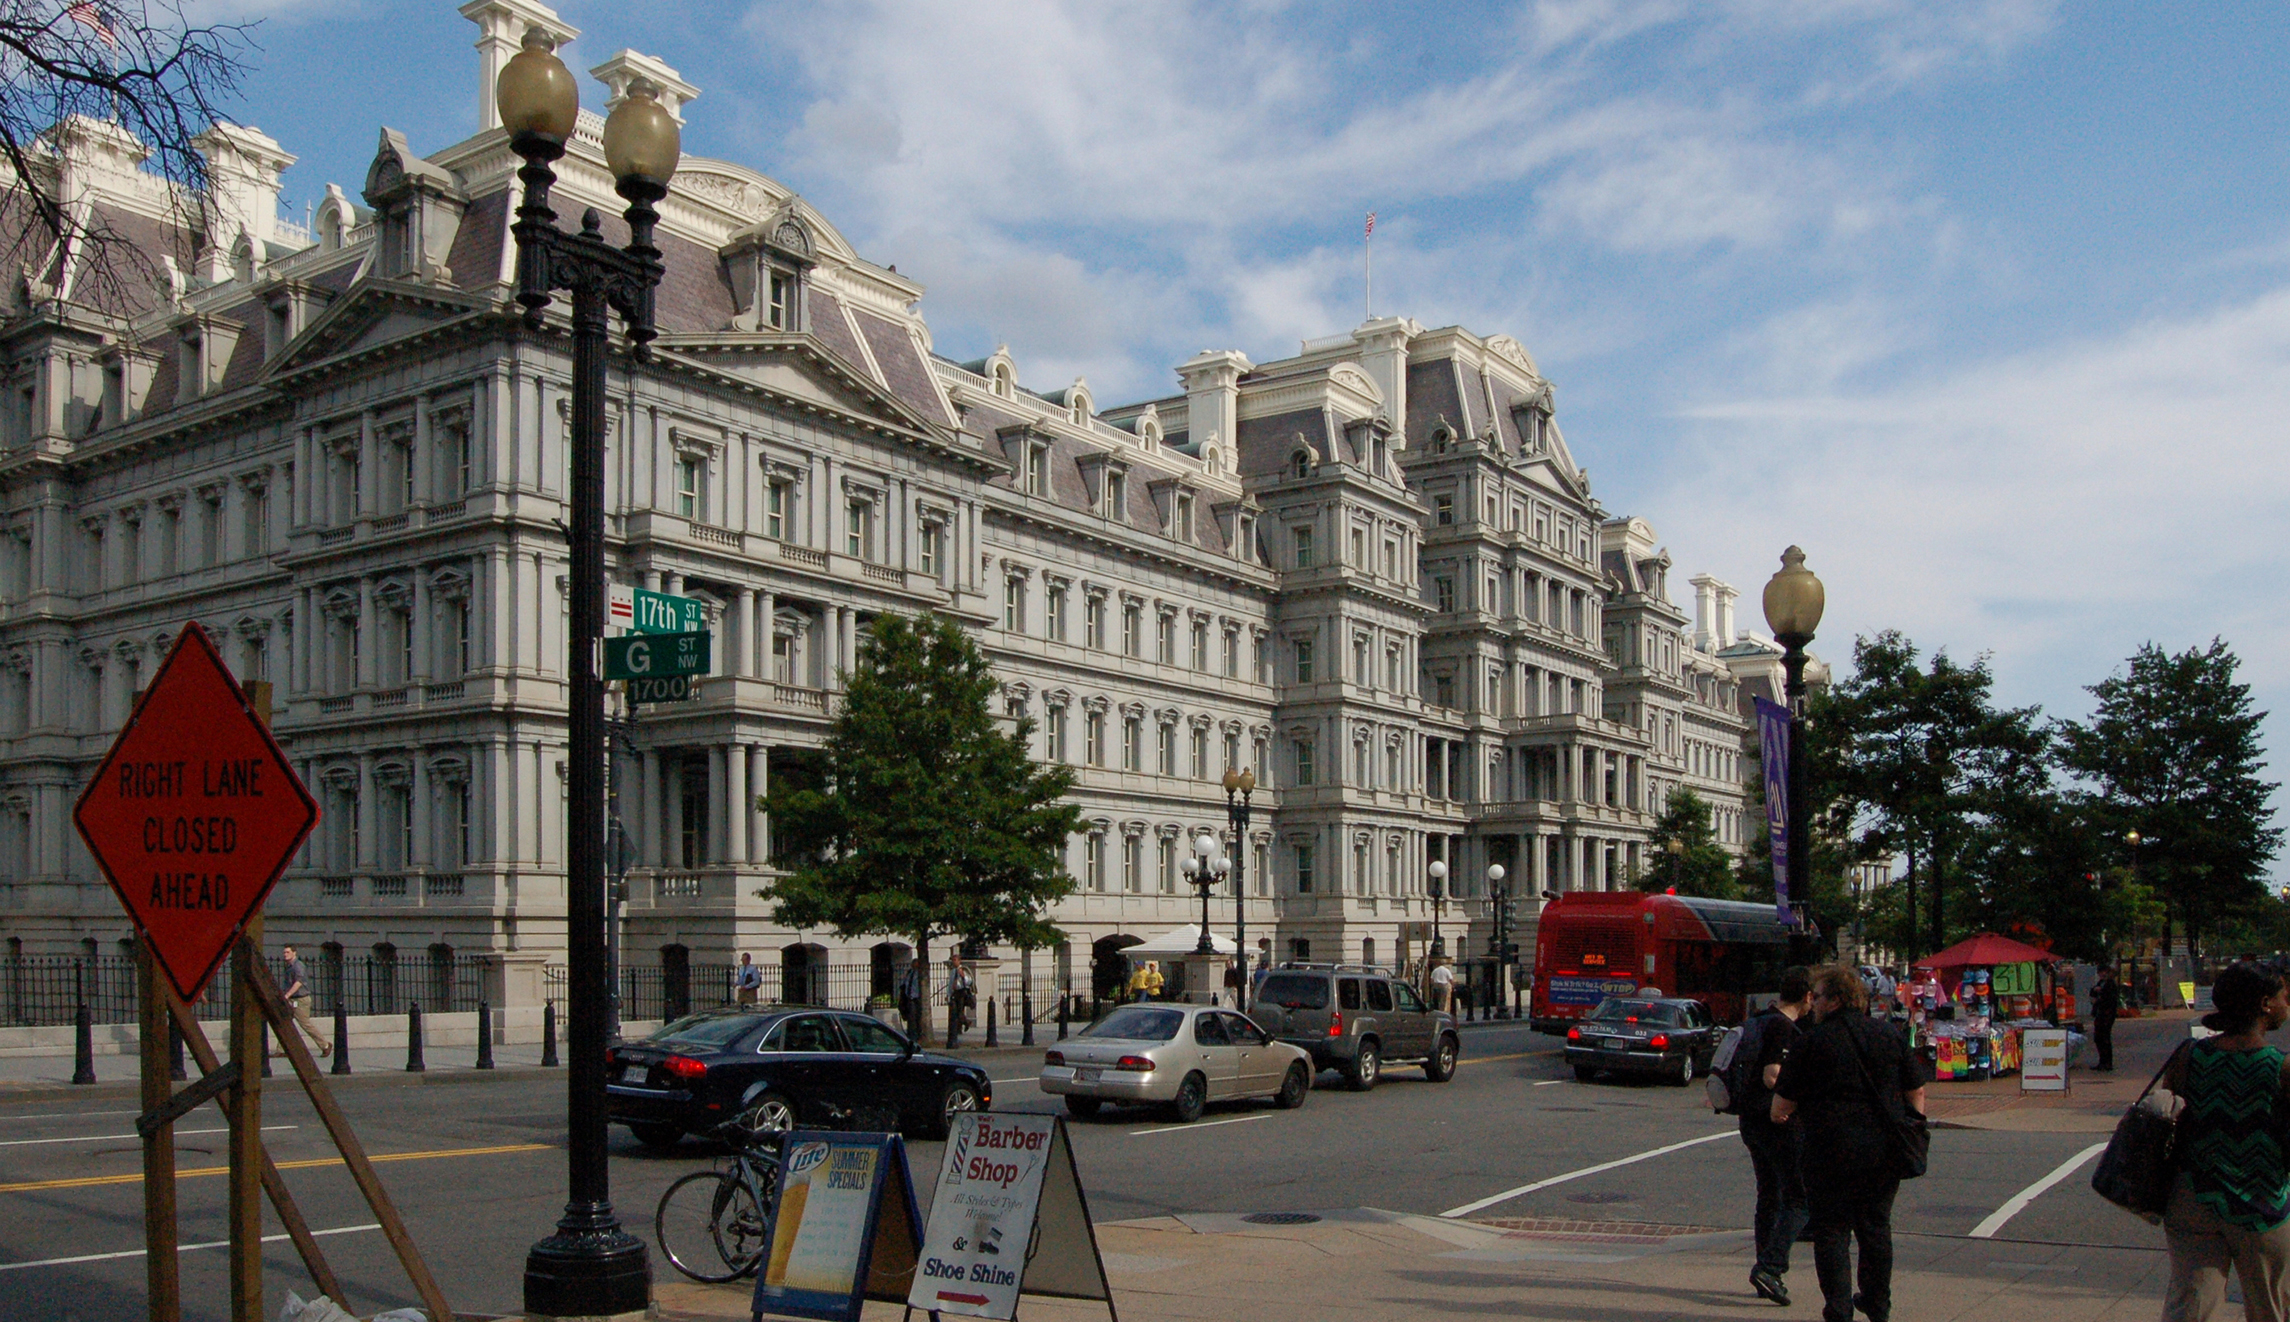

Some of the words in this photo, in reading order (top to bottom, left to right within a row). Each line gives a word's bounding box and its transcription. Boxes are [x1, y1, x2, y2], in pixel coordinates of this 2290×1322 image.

[640, 596, 676, 631] 17th
[685, 603, 696, 619] ST
[684, 620, 698, 632] NW
[626, 641, 651, 673] G
[678, 637, 696, 652] ST
[678, 654, 698, 668] NW
[630, 677, 686, 700] 1700
[119, 761, 187, 798] RIGHT
[203, 758, 264, 797] LANE
[143, 816, 237, 853] CLOSED
[149, 872, 230, 910] AHEAD
[1603, 984, 1632, 993] WTOP
[2025, 1038, 2065, 1048] SUBWAY
[2024, 1057, 2064, 1066] SUBWAY
[974, 1123, 1048, 1151] Barber
[791, 1147, 826, 1173] Lite
[832, 1150, 870, 1170] SUMMER
[827, 1170, 867, 1190] SPECIALS
[966, 1156, 1018, 1189] Shop
[950, 1193, 965, 1204] All
[965, 1195, 989, 1206] Styles
[990, 1196, 1000, 1207] &
[1002, 1197, 1023, 1212] Types
[952, 1236, 968, 1252] &
[924, 1257, 965, 1280] Shoe
[970, 1264, 1015, 1286] Shine
